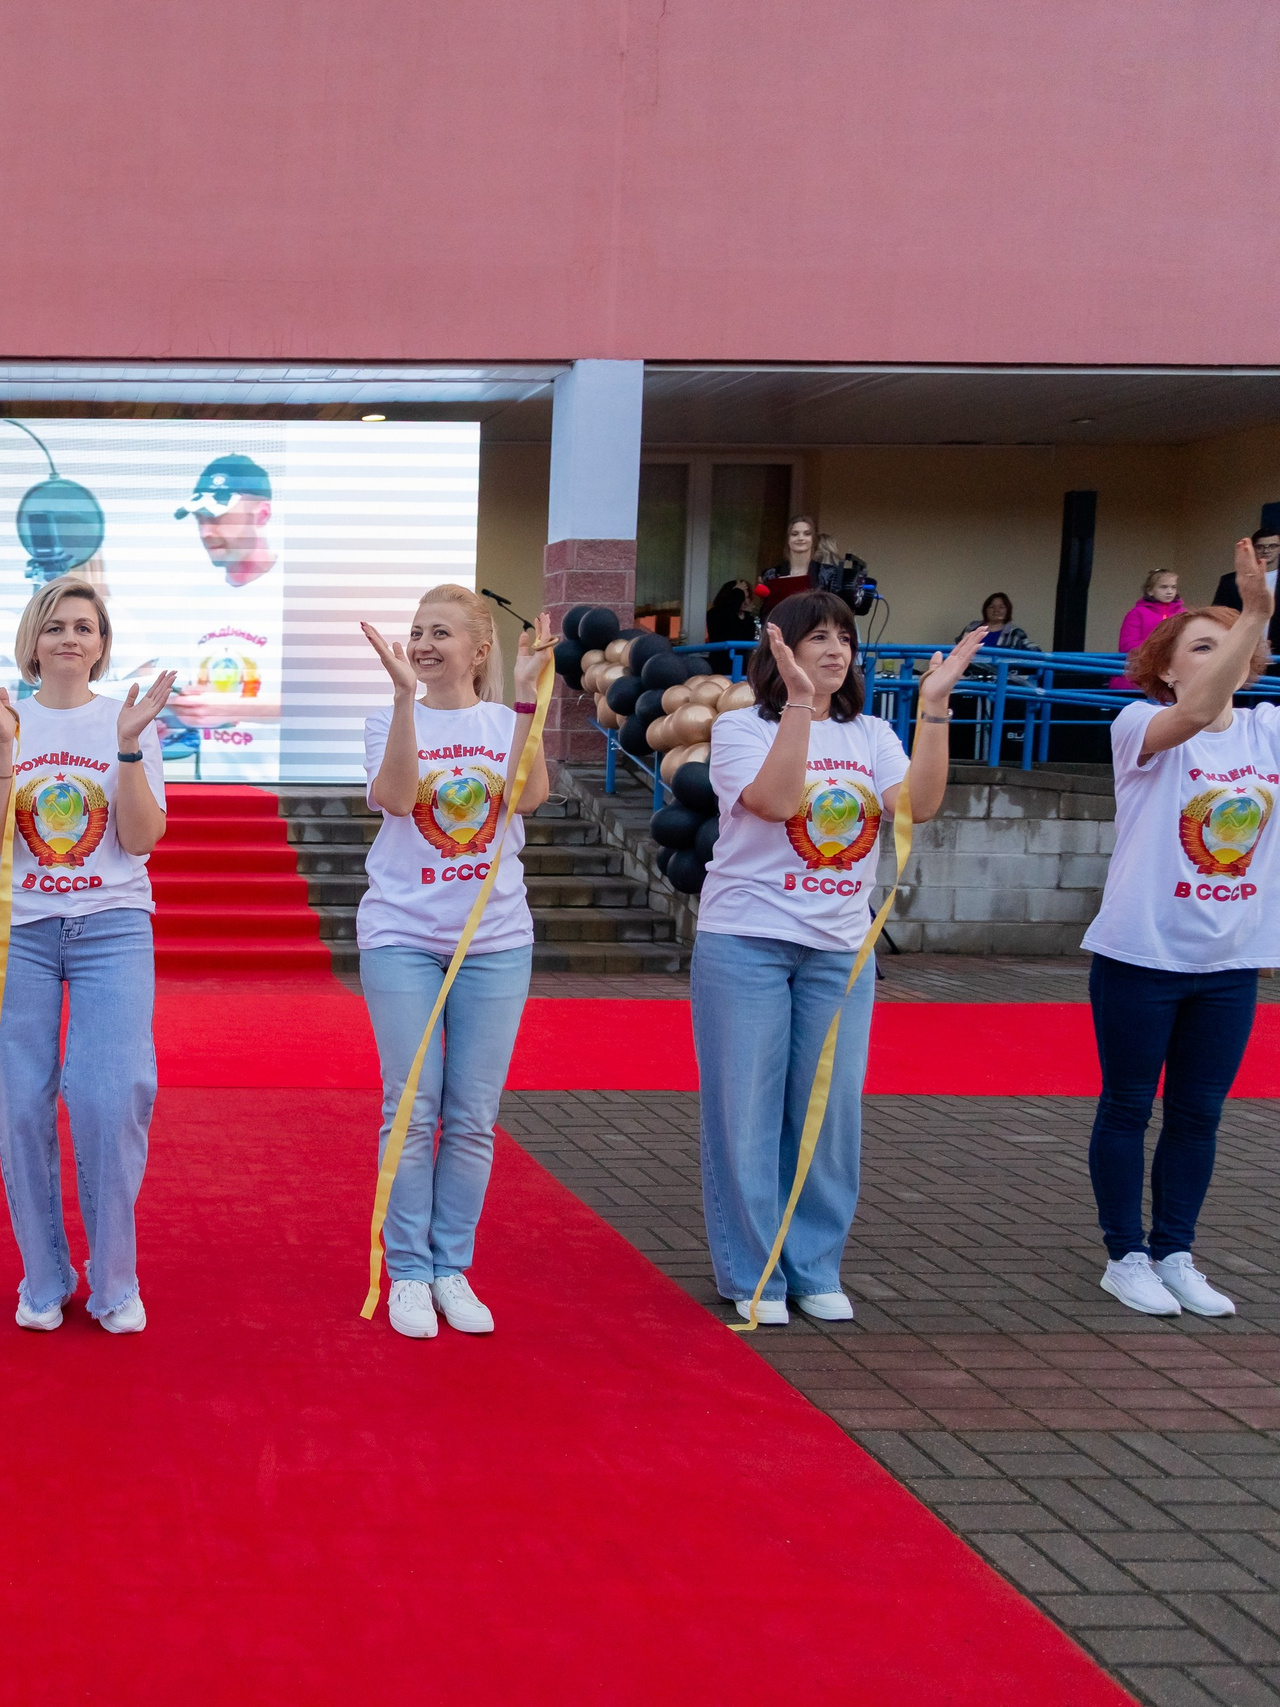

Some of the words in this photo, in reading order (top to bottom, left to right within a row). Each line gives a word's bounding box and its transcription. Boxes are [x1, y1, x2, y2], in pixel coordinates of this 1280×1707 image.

[12, 751, 110, 776] РОЖДЁННАЯ
[418, 744, 507, 763] ОЖДЁННАЯ
[21, 873, 38, 890] В
[39, 875, 103, 893] СССР
[421, 867, 436, 885] В
[441, 861, 494, 882] ССС
[784, 873, 797, 891] В
[802, 876, 862, 897] СССР
[1174, 881, 1192, 898] В
